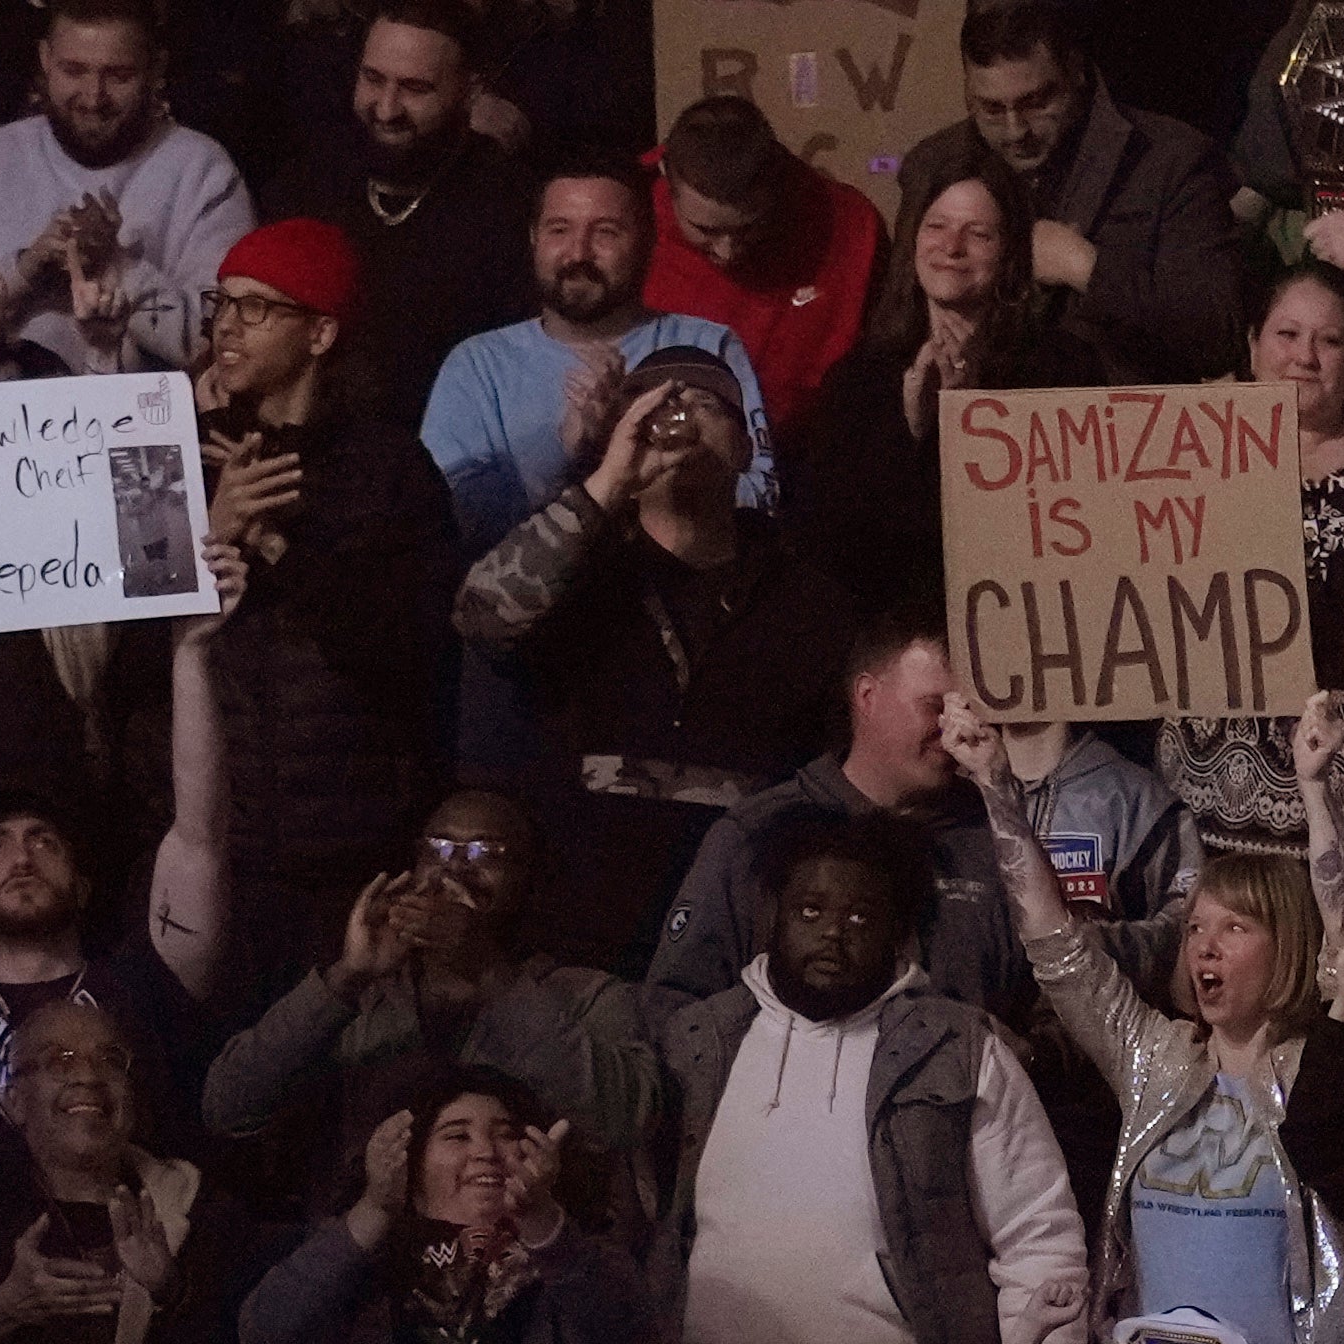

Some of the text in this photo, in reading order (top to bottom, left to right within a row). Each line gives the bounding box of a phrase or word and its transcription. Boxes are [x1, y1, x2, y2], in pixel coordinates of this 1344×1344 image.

[1133, 495, 1207, 565] MY
[965, 568, 1302, 713] CHAMP
[1066, 880, 1096, 893] 023
